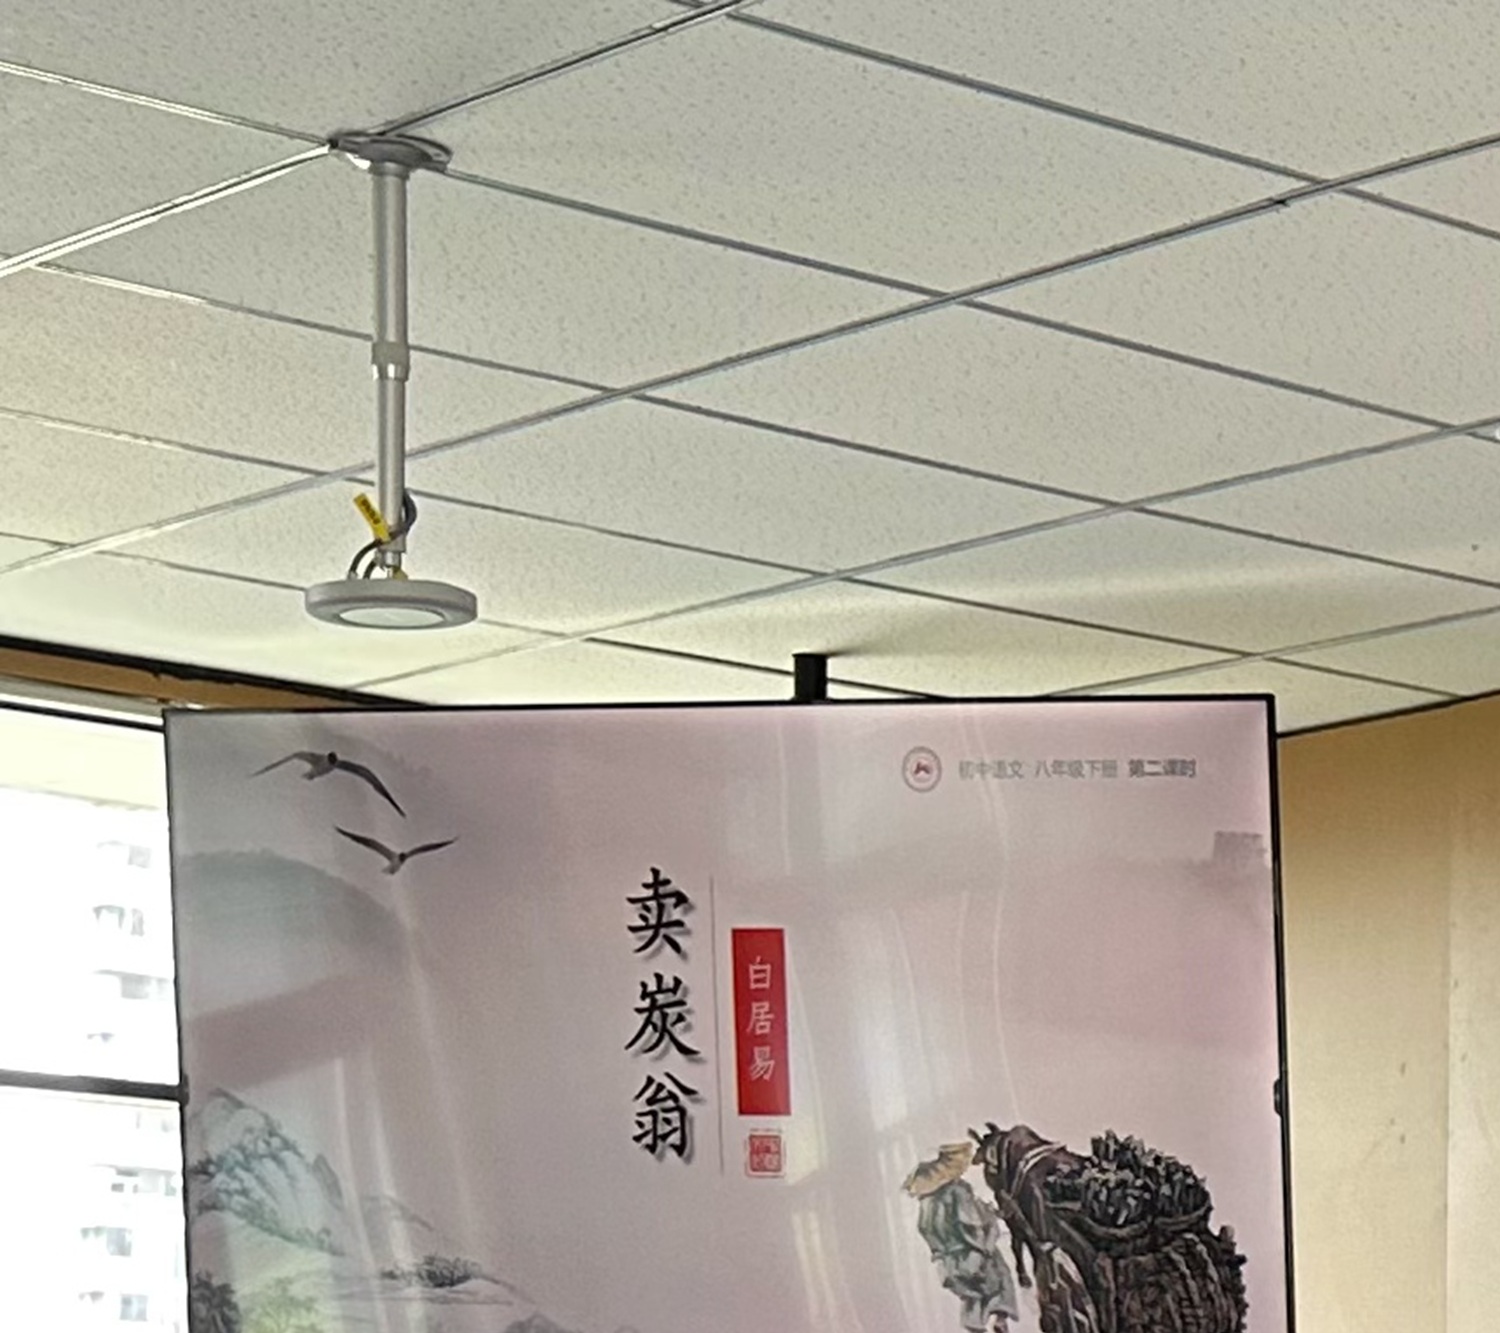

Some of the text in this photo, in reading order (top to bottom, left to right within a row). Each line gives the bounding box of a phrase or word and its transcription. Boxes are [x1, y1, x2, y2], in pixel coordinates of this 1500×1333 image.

[624, 866, 702, 1158] 卖炭翁
[747, 956, 775, 1081] 白居易
